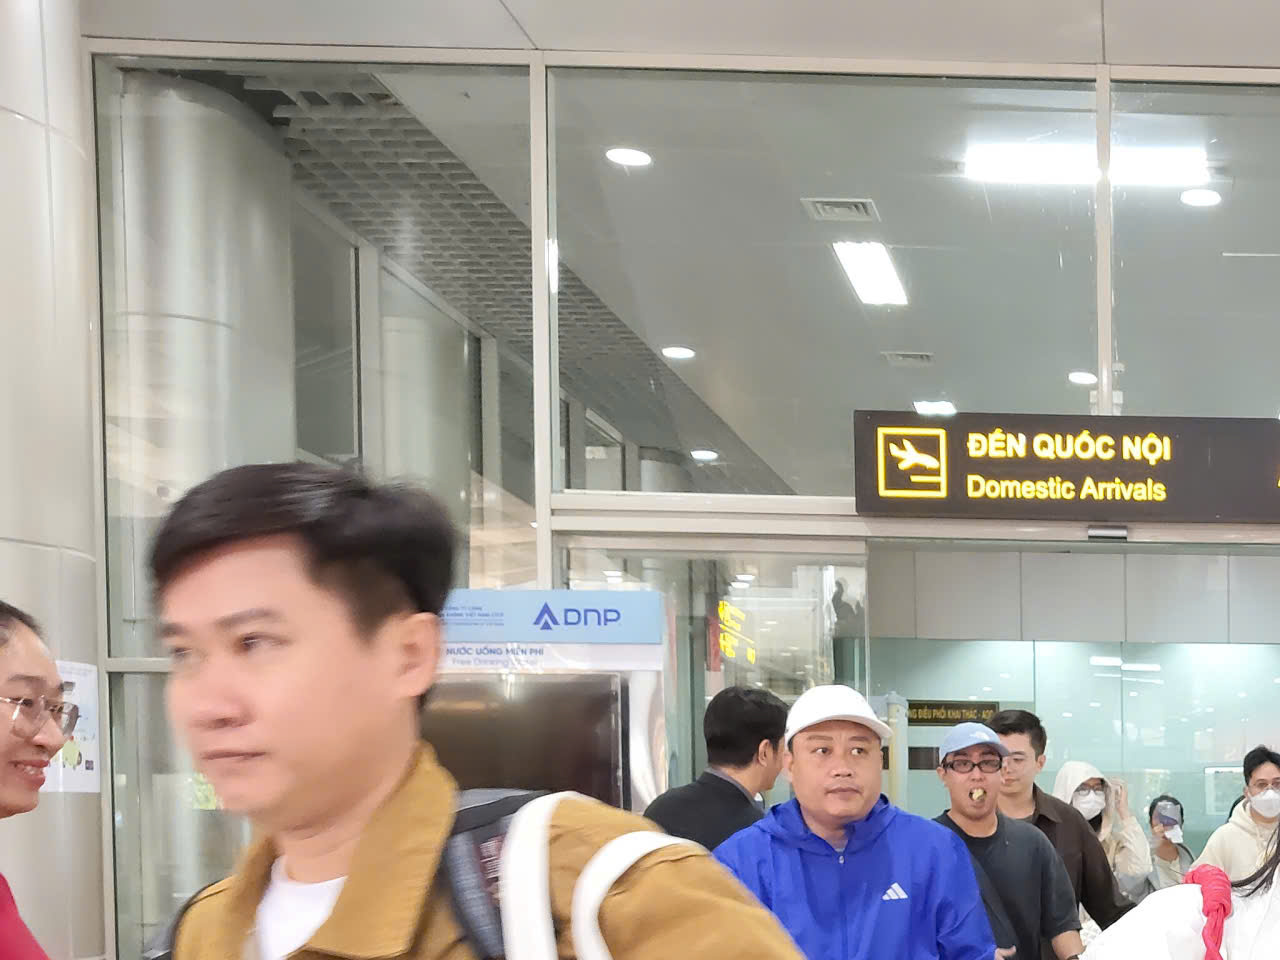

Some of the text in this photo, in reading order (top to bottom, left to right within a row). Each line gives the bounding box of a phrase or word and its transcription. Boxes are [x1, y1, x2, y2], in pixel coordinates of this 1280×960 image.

[1122, 432, 1171, 466] NỘI
[967, 474, 1167, 501] Domestic Arrivals
[563, 608, 621, 626] DNP
